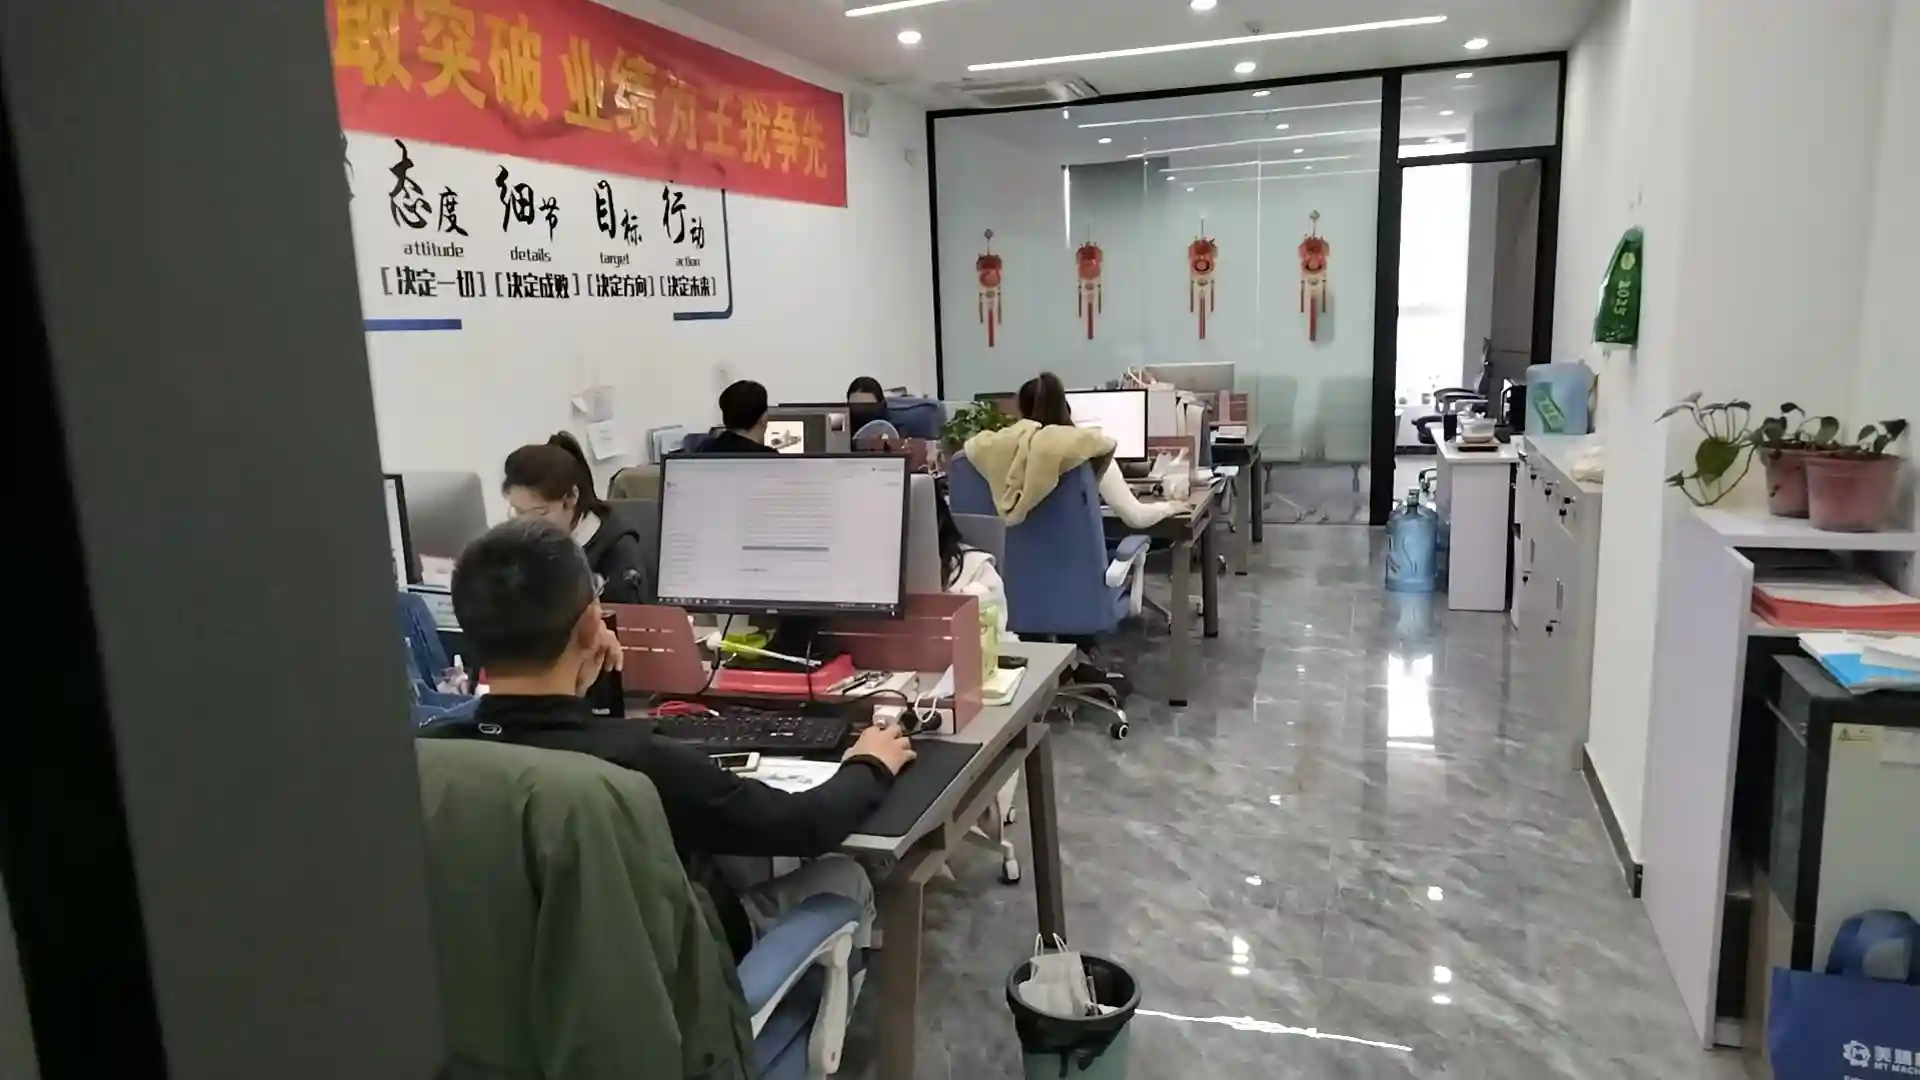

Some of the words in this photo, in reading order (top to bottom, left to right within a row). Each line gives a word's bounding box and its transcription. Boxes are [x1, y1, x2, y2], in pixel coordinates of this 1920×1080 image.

[389, 139, 469, 236] 态度
[495, 164, 560, 242] 细节
[594, 180, 642, 246] 目标
[662, 180, 705, 249] 行动
[403, 240, 465, 258] attitude
[510, 246, 552, 262] details
[600, 252, 630, 268] target
[675, 256, 701, 267] action
